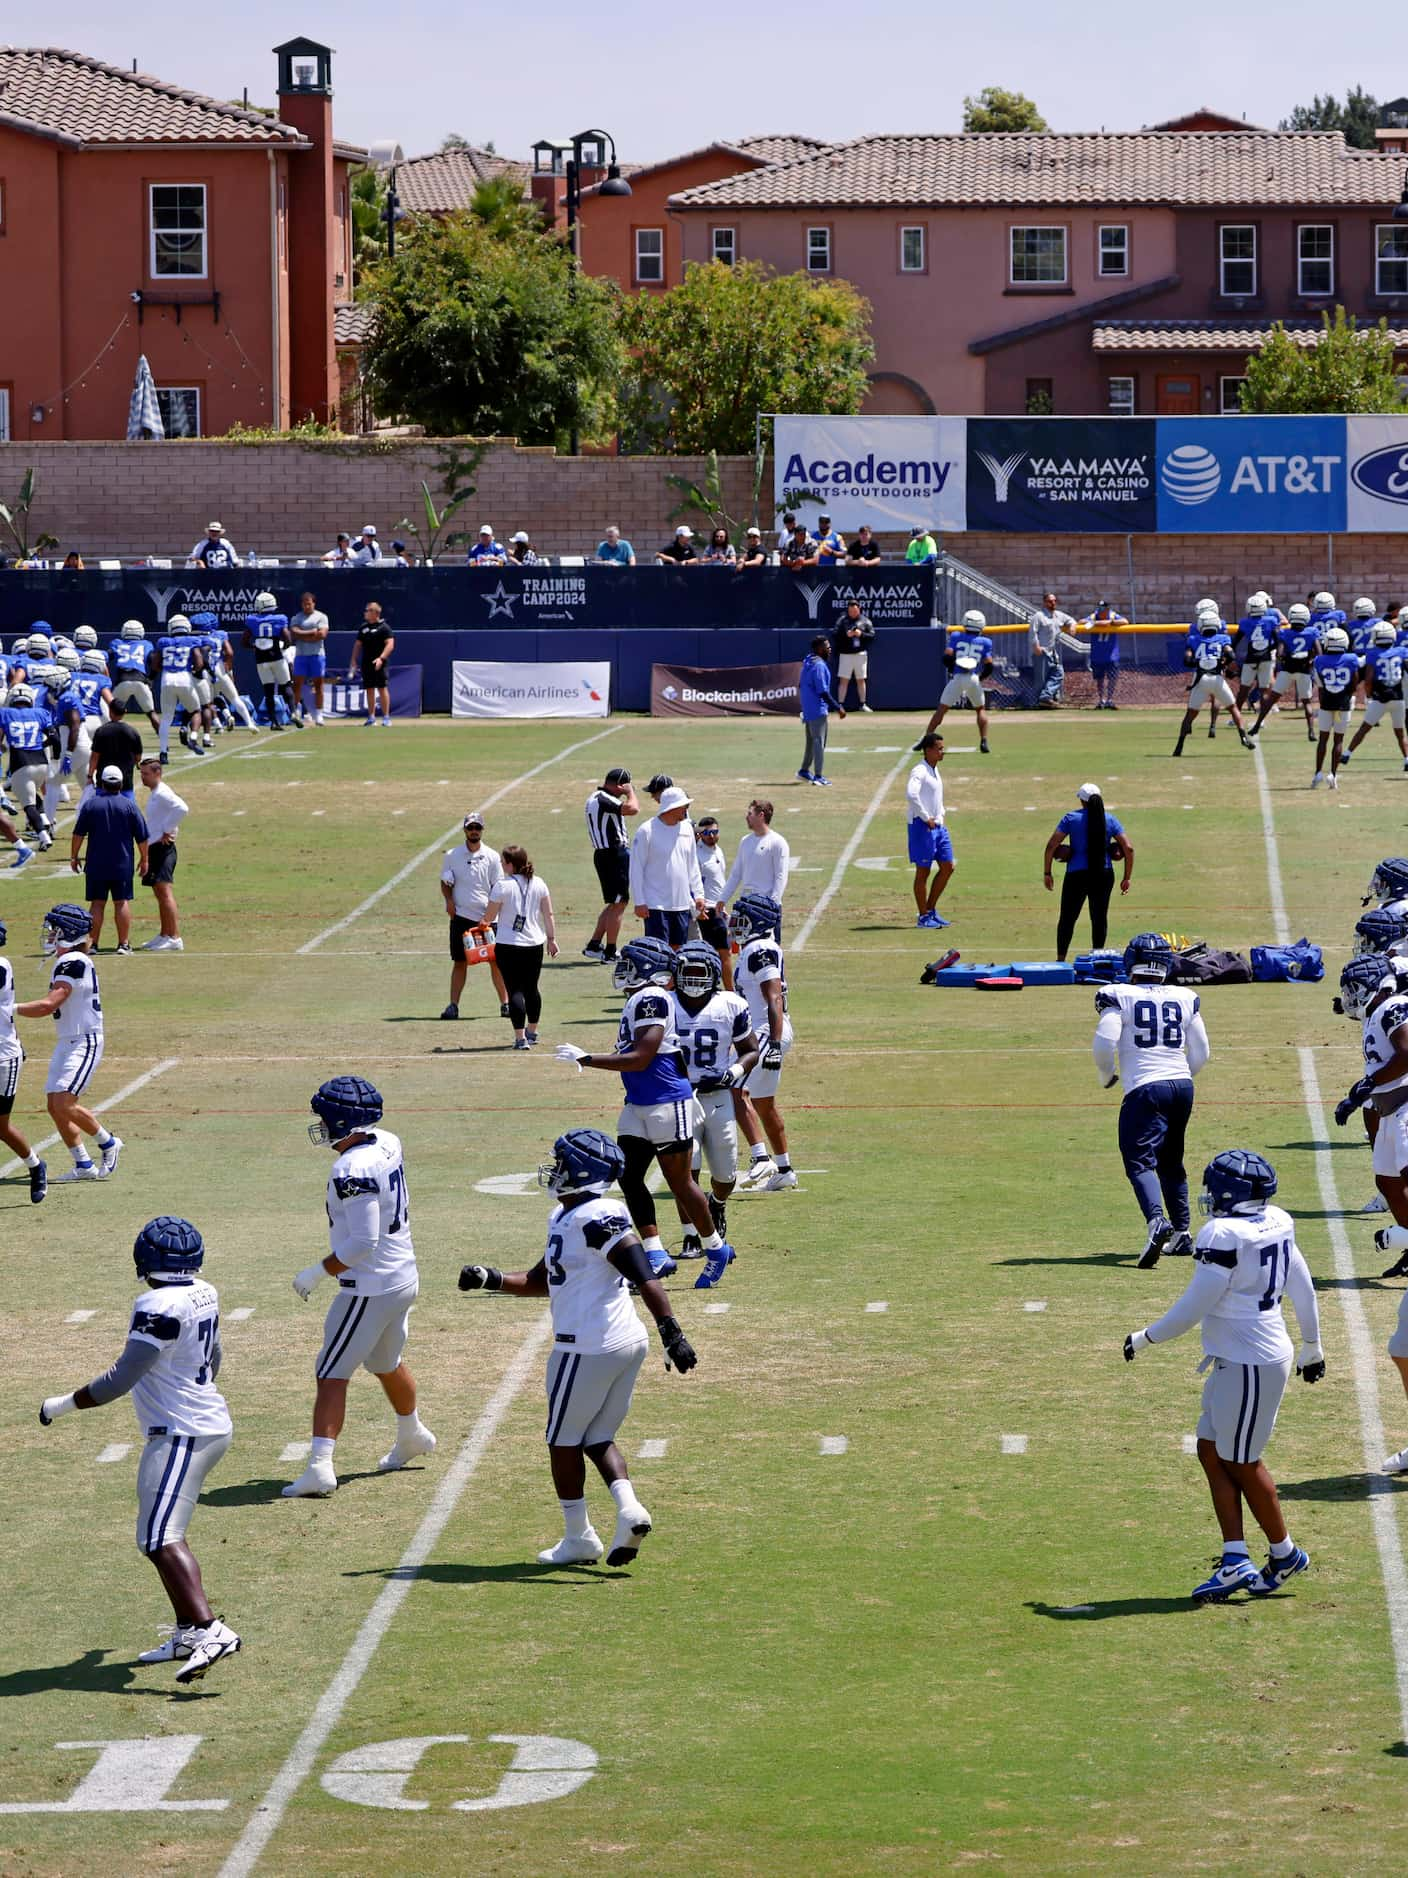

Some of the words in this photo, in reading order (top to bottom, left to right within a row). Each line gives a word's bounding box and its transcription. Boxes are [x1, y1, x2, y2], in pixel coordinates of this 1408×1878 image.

[784, 453, 951, 494] Academy
[1230, 456, 1341, 494] AT&T
[1027, 477, 1081, 489] RESORT
[1085, 477, 1095, 488] &
[1098, 477, 1149, 489] CASINO
[1050, 489, 1078, 501] SAN
[1082, 489, 1138, 501] MANUEL
[522, 578, 586, 591] TRAINING
[182, 587, 271, 601] YAAMAV'
[181, 603, 222, 612] RESORT
[224, 603, 232, 612] &
[832, 600, 872, 609] RESRT
[874, 600, 882, 609] &
[884, 600, 923, 609] CASINO
[872, 609, 914, 618] MANUEL
[1251, 626, 1265, 643] 4
[955, 641, 985, 663] 25
[1293, 637, 1306, 653] 2
[116, 645, 145, 665] 54
[162, 646, 191, 667] 53
[459, 684, 526, 698] American
[527, 685, 579, 698] Airlines
[682, 685, 798, 702] Blockchain.com
[8, 720, 40, 748] 97
[1134, 1000, 1183, 1049] 98
[1258, 1238, 1291, 1312] 71
